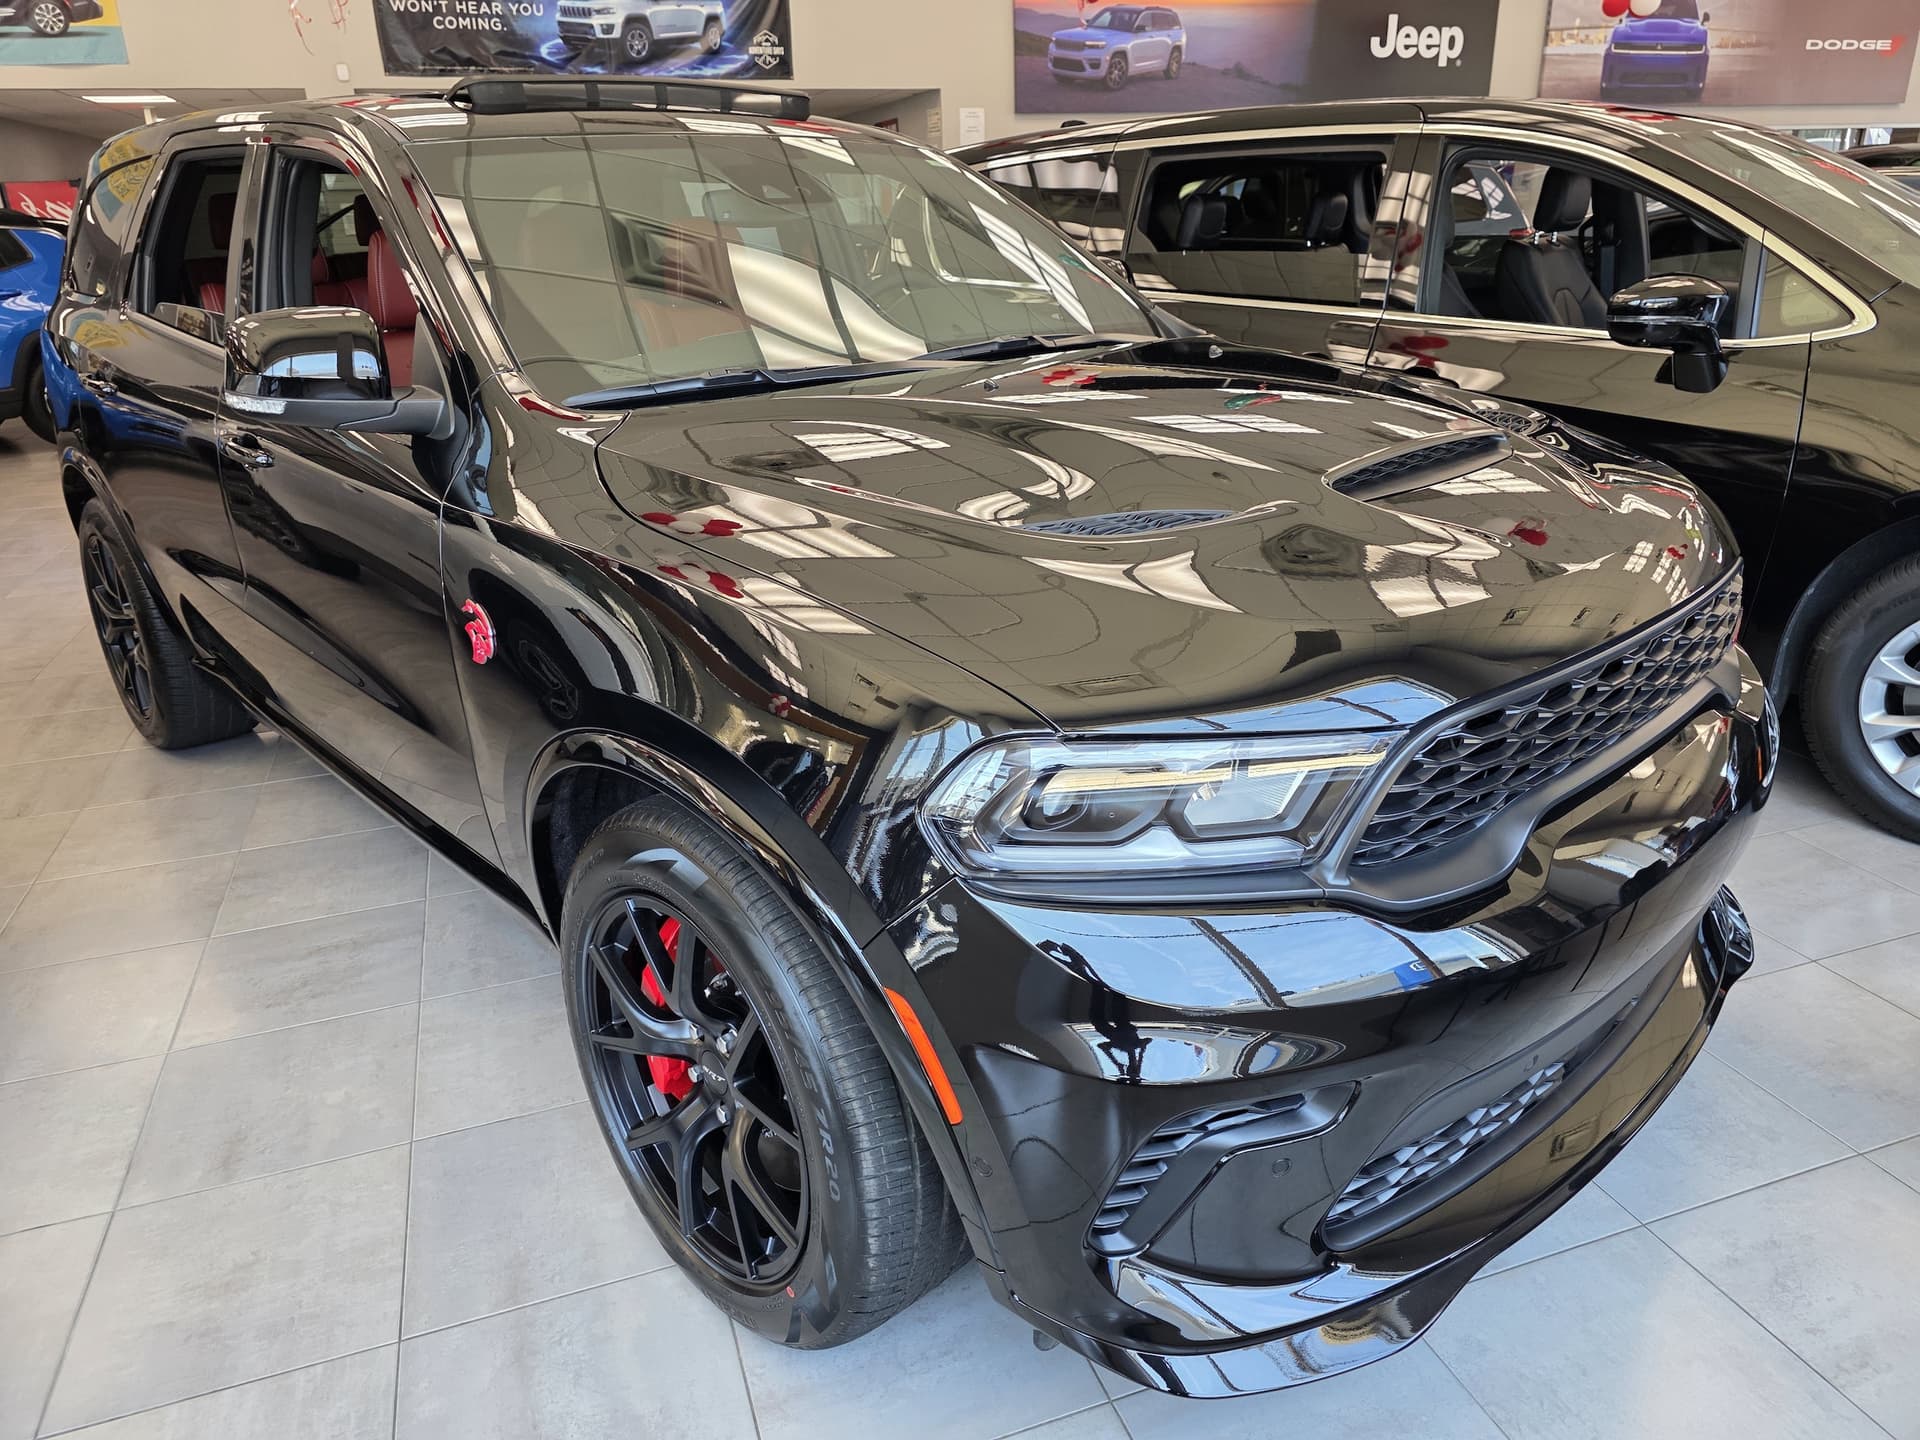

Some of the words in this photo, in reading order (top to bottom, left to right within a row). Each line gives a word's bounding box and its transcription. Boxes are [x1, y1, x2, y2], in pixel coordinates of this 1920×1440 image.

[389, 0, 449, 13] WON'T
[456, 2, 502, 15] HEAR
[509, 3, 544, 16] YOU
[433, 16, 508, 31] COMING.
[1370, 13, 1464, 67] Jeep
[1805, 39, 1893, 50] DODGE
